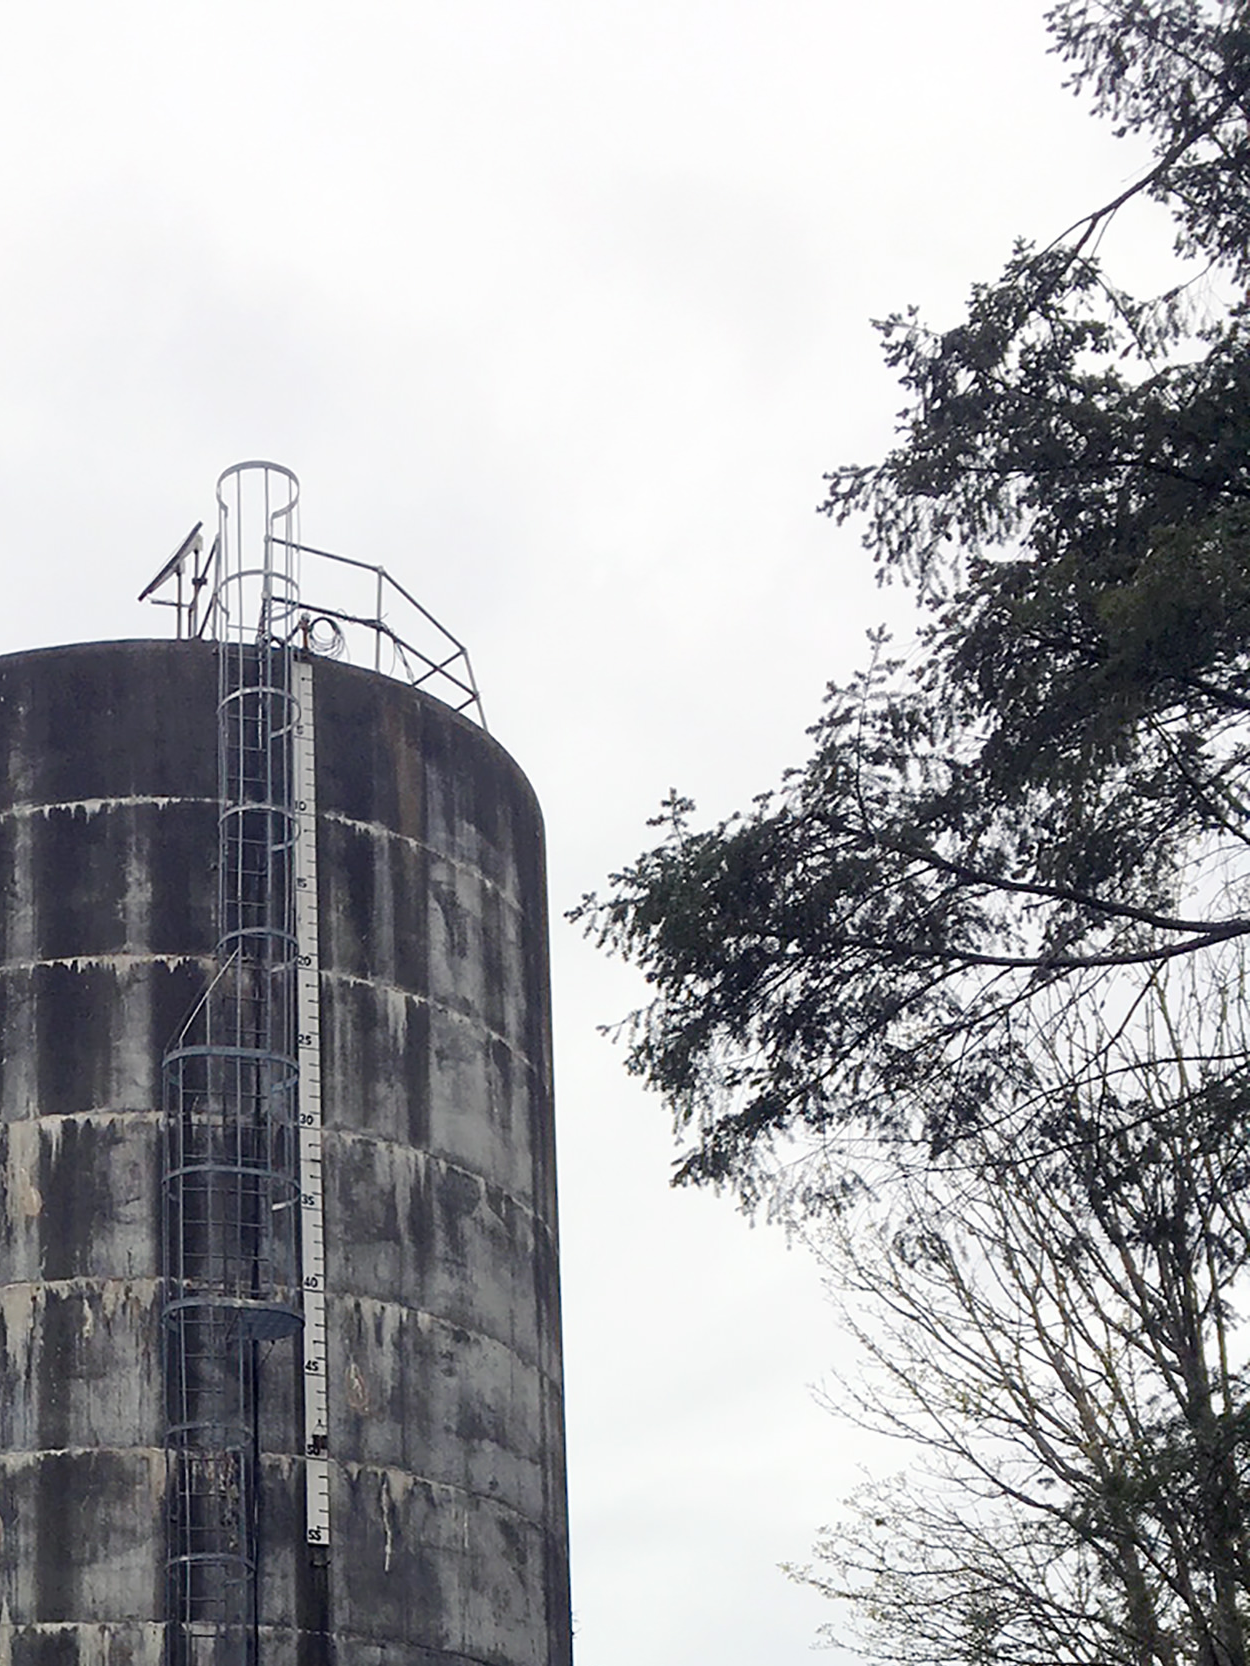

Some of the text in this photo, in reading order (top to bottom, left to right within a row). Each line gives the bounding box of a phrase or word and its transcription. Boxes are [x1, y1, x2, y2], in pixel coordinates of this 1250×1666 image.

[294, 800, 307, 811] 10
[297, 955, 311, 967] 20
[298, 1034, 312, 1046] 25
[299, 1113, 314, 1126] 30
[301, 1193, 315, 1206] 35
[304, 1276, 318, 1288] 40
[305, 1359, 319, 1371] 45
[308, 1529, 322, 1541] 55
